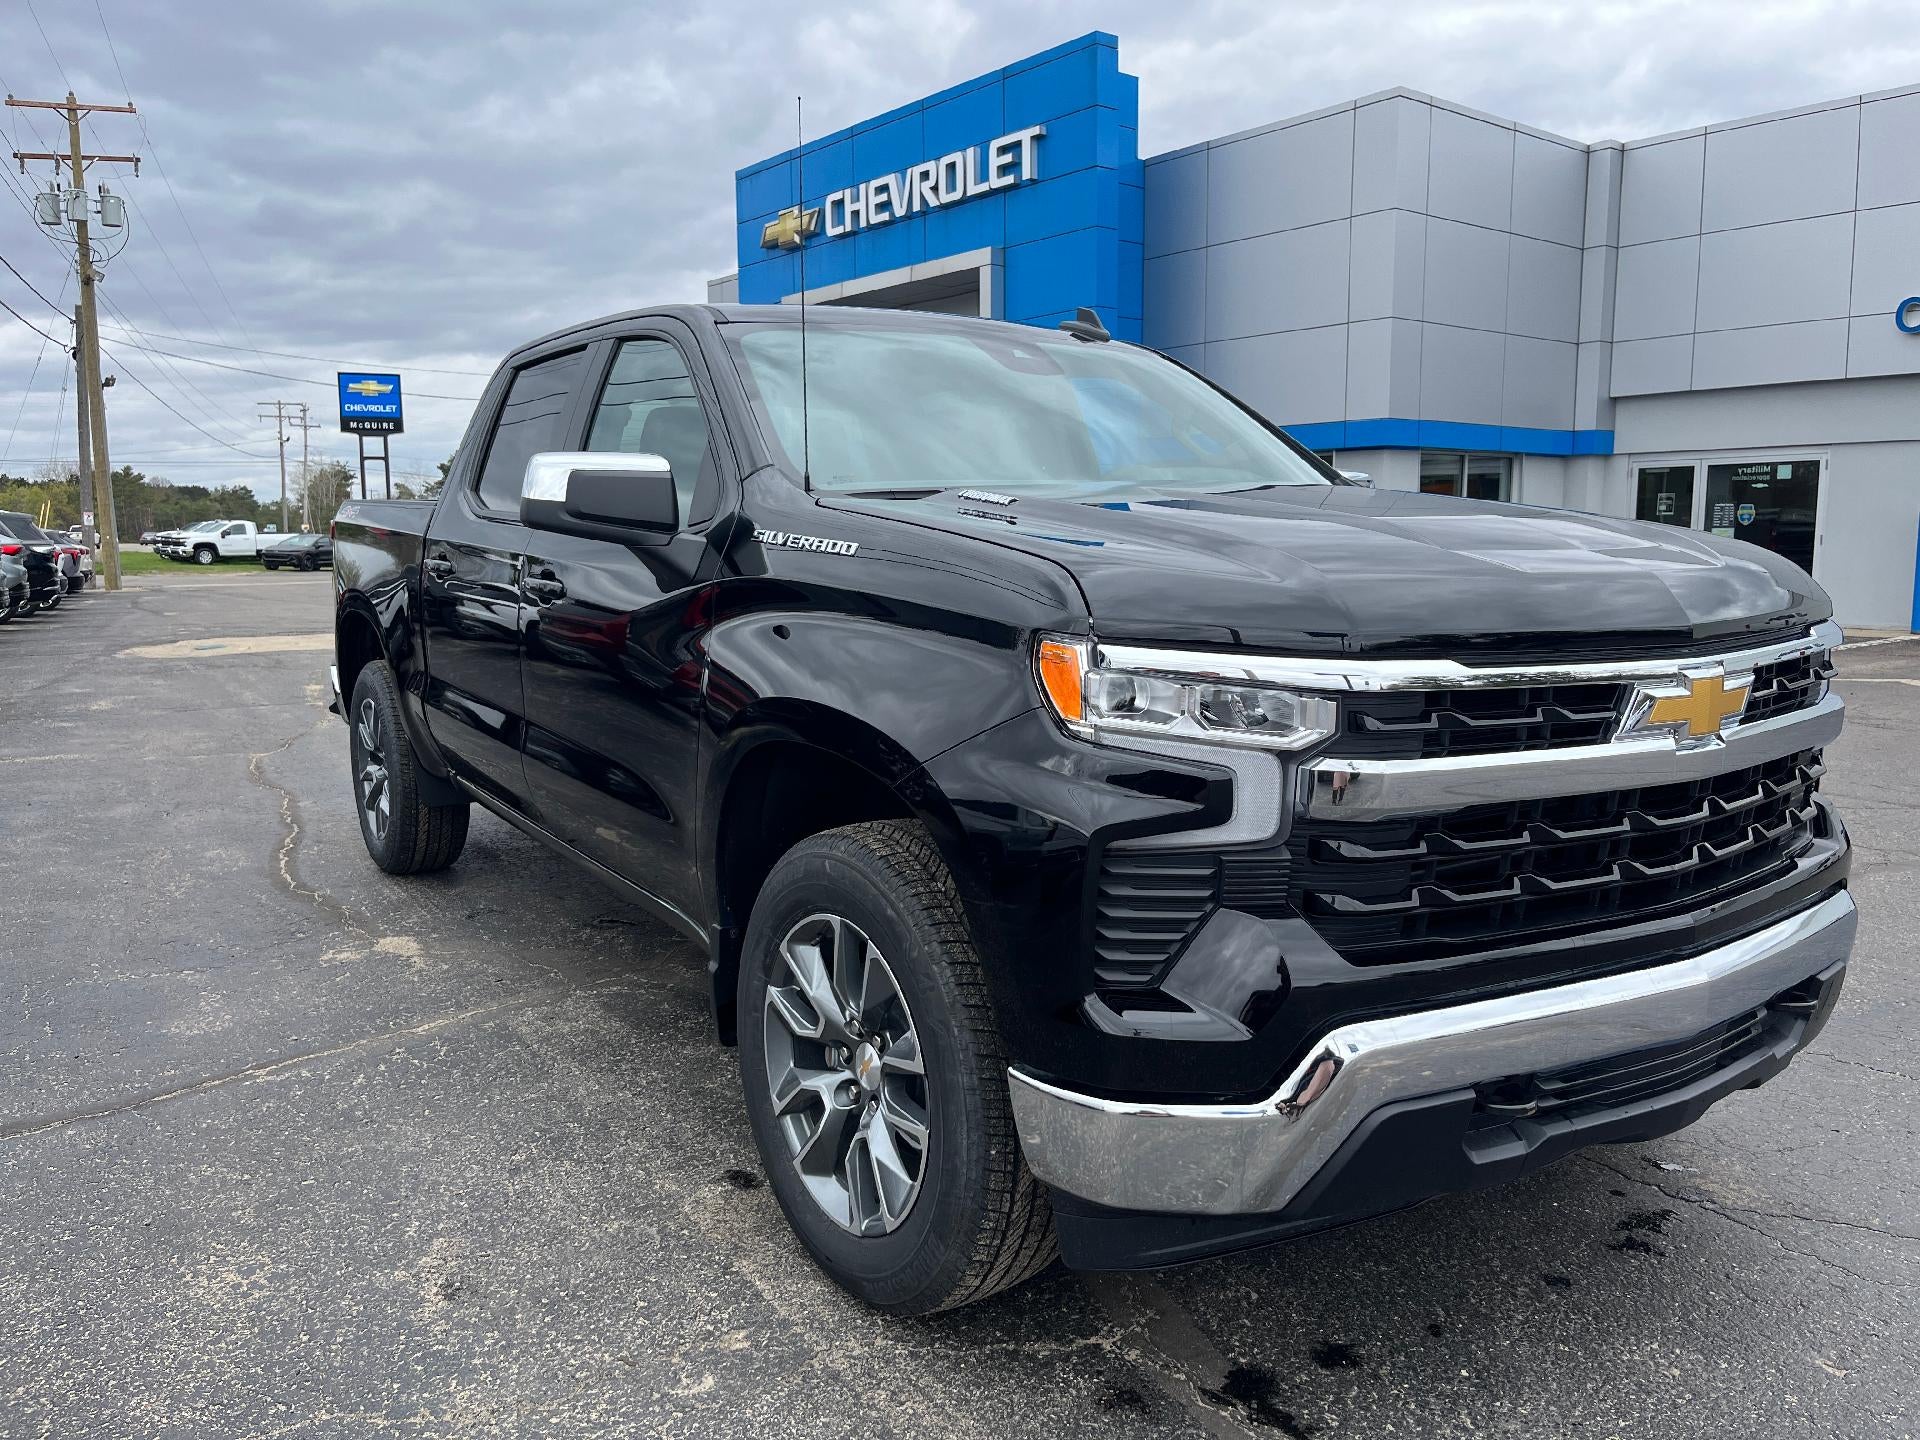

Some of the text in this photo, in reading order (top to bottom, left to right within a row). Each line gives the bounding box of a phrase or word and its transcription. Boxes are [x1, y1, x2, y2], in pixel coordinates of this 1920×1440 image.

[825, 125, 1046, 237] CHEVROLET
[345, 404, 397, 413] CHEVROLET
[753, 529, 859, 556] SILVERADO
